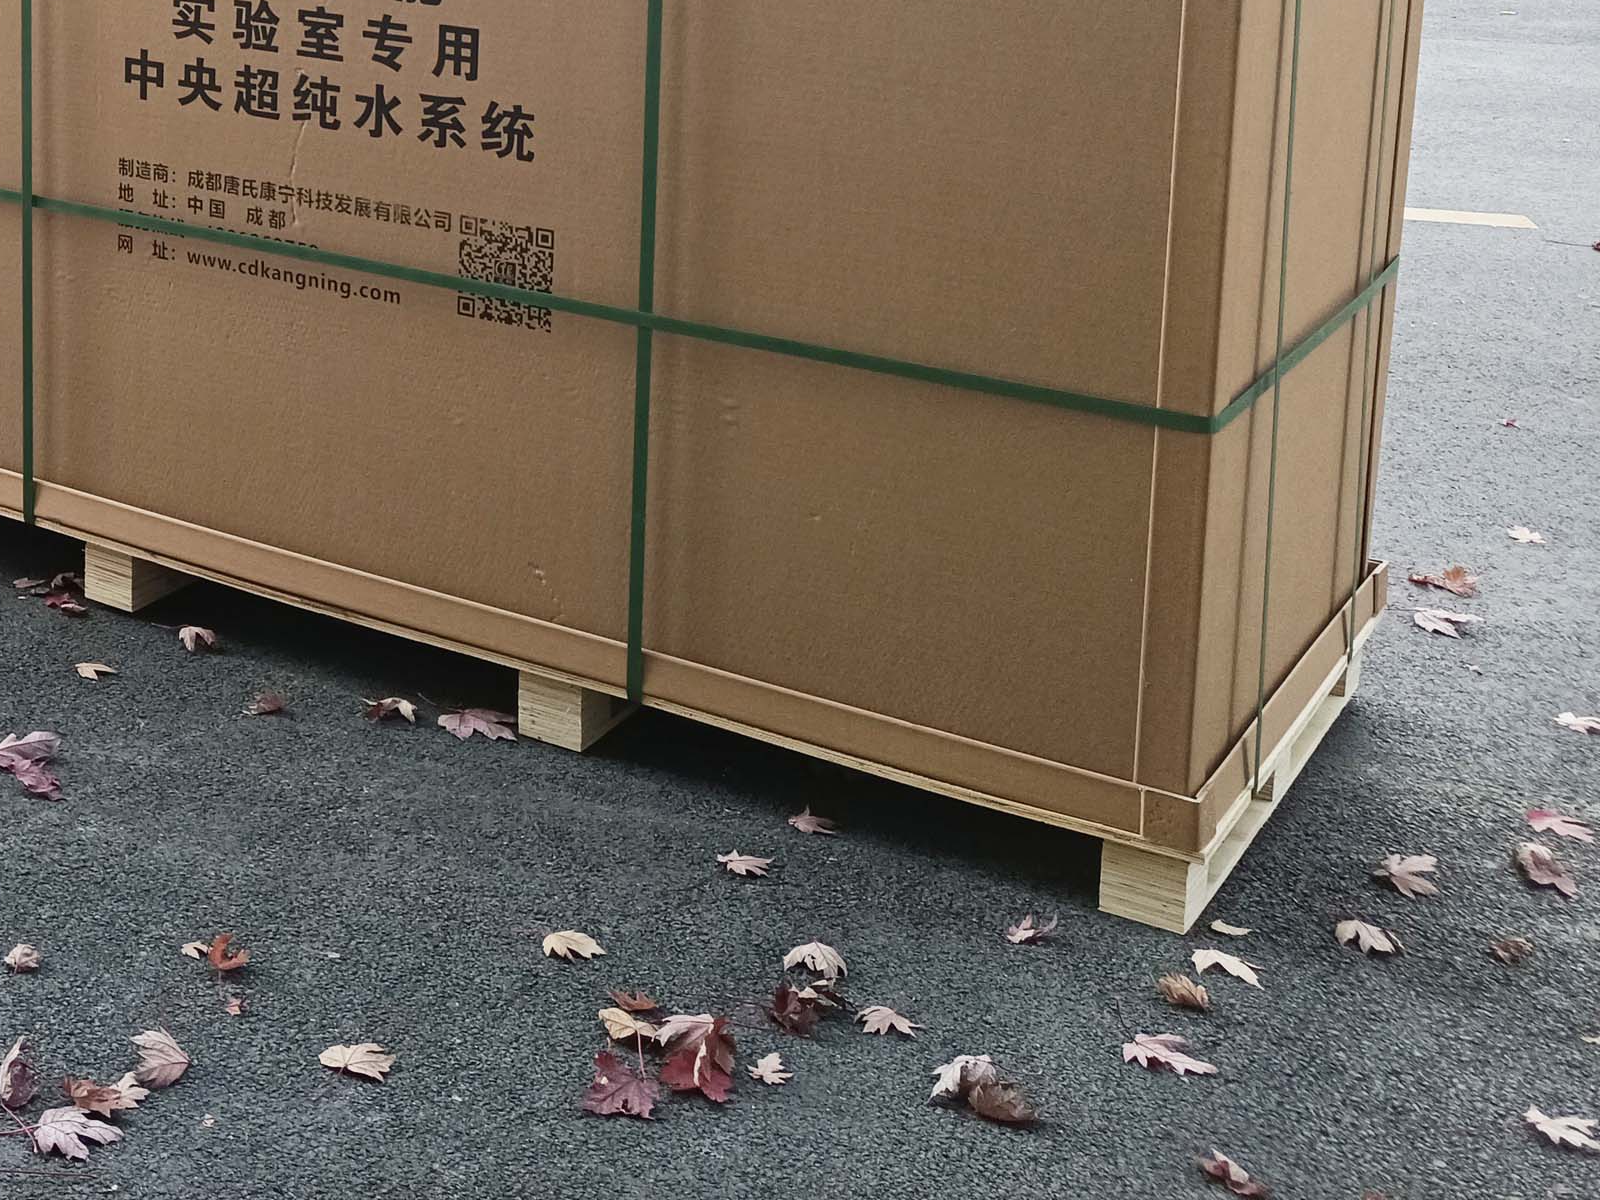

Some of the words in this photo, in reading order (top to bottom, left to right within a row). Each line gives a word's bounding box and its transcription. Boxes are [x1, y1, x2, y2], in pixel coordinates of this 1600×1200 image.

[123, 48, 536, 163] 中央超纯水系统
